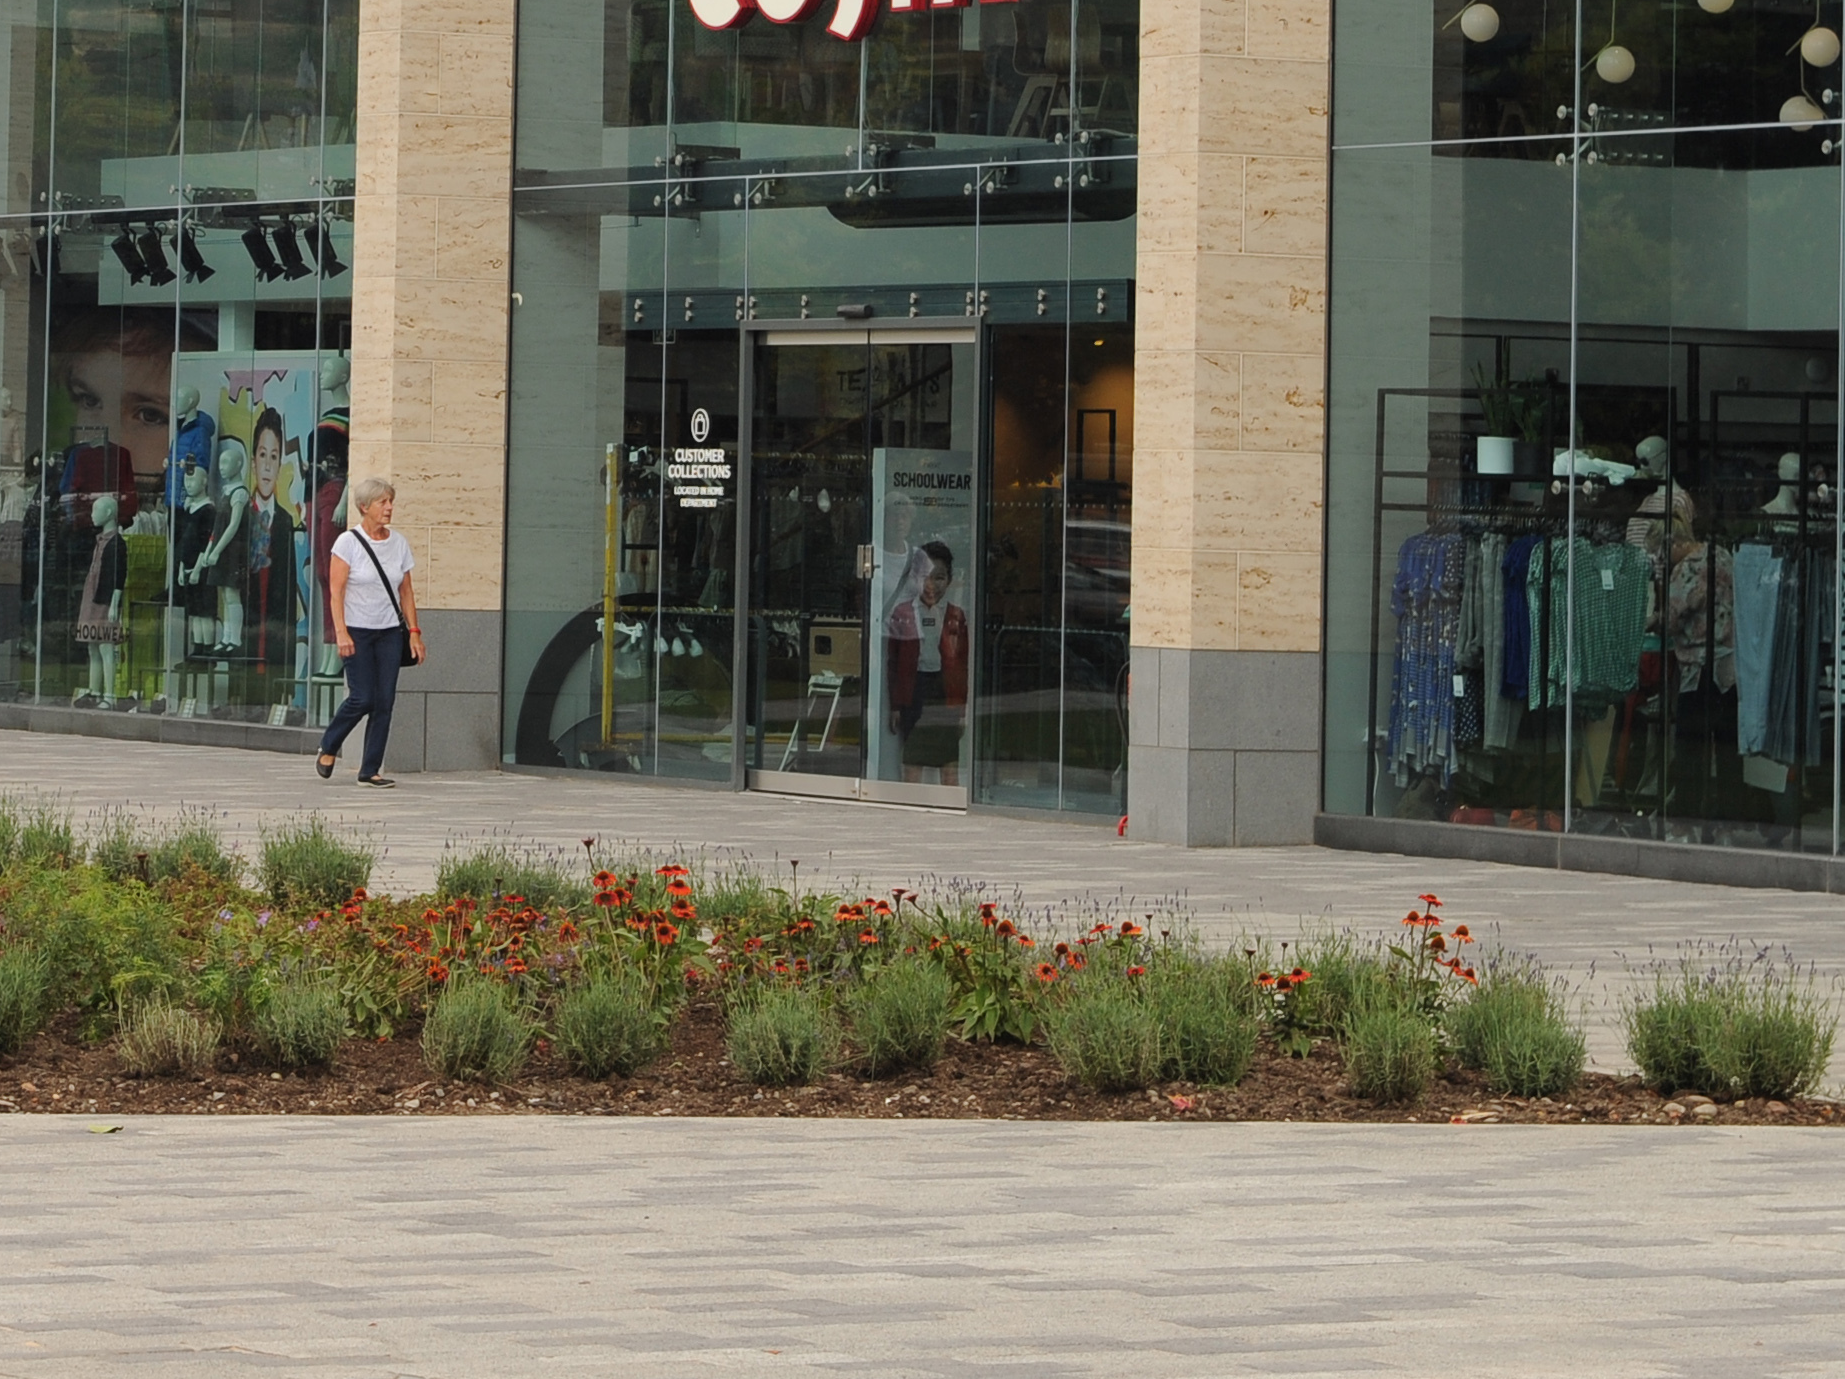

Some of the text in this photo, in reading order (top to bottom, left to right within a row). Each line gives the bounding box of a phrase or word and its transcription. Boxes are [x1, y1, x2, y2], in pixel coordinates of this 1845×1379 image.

[675, 448, 725, 463] CUSTOMER
[668, 464, 731, 479] COLLECTIONS
[893, 472, 972, 490] SCHOOLWEAR
[65, 623, 132, 642] CHOOLWEAR
